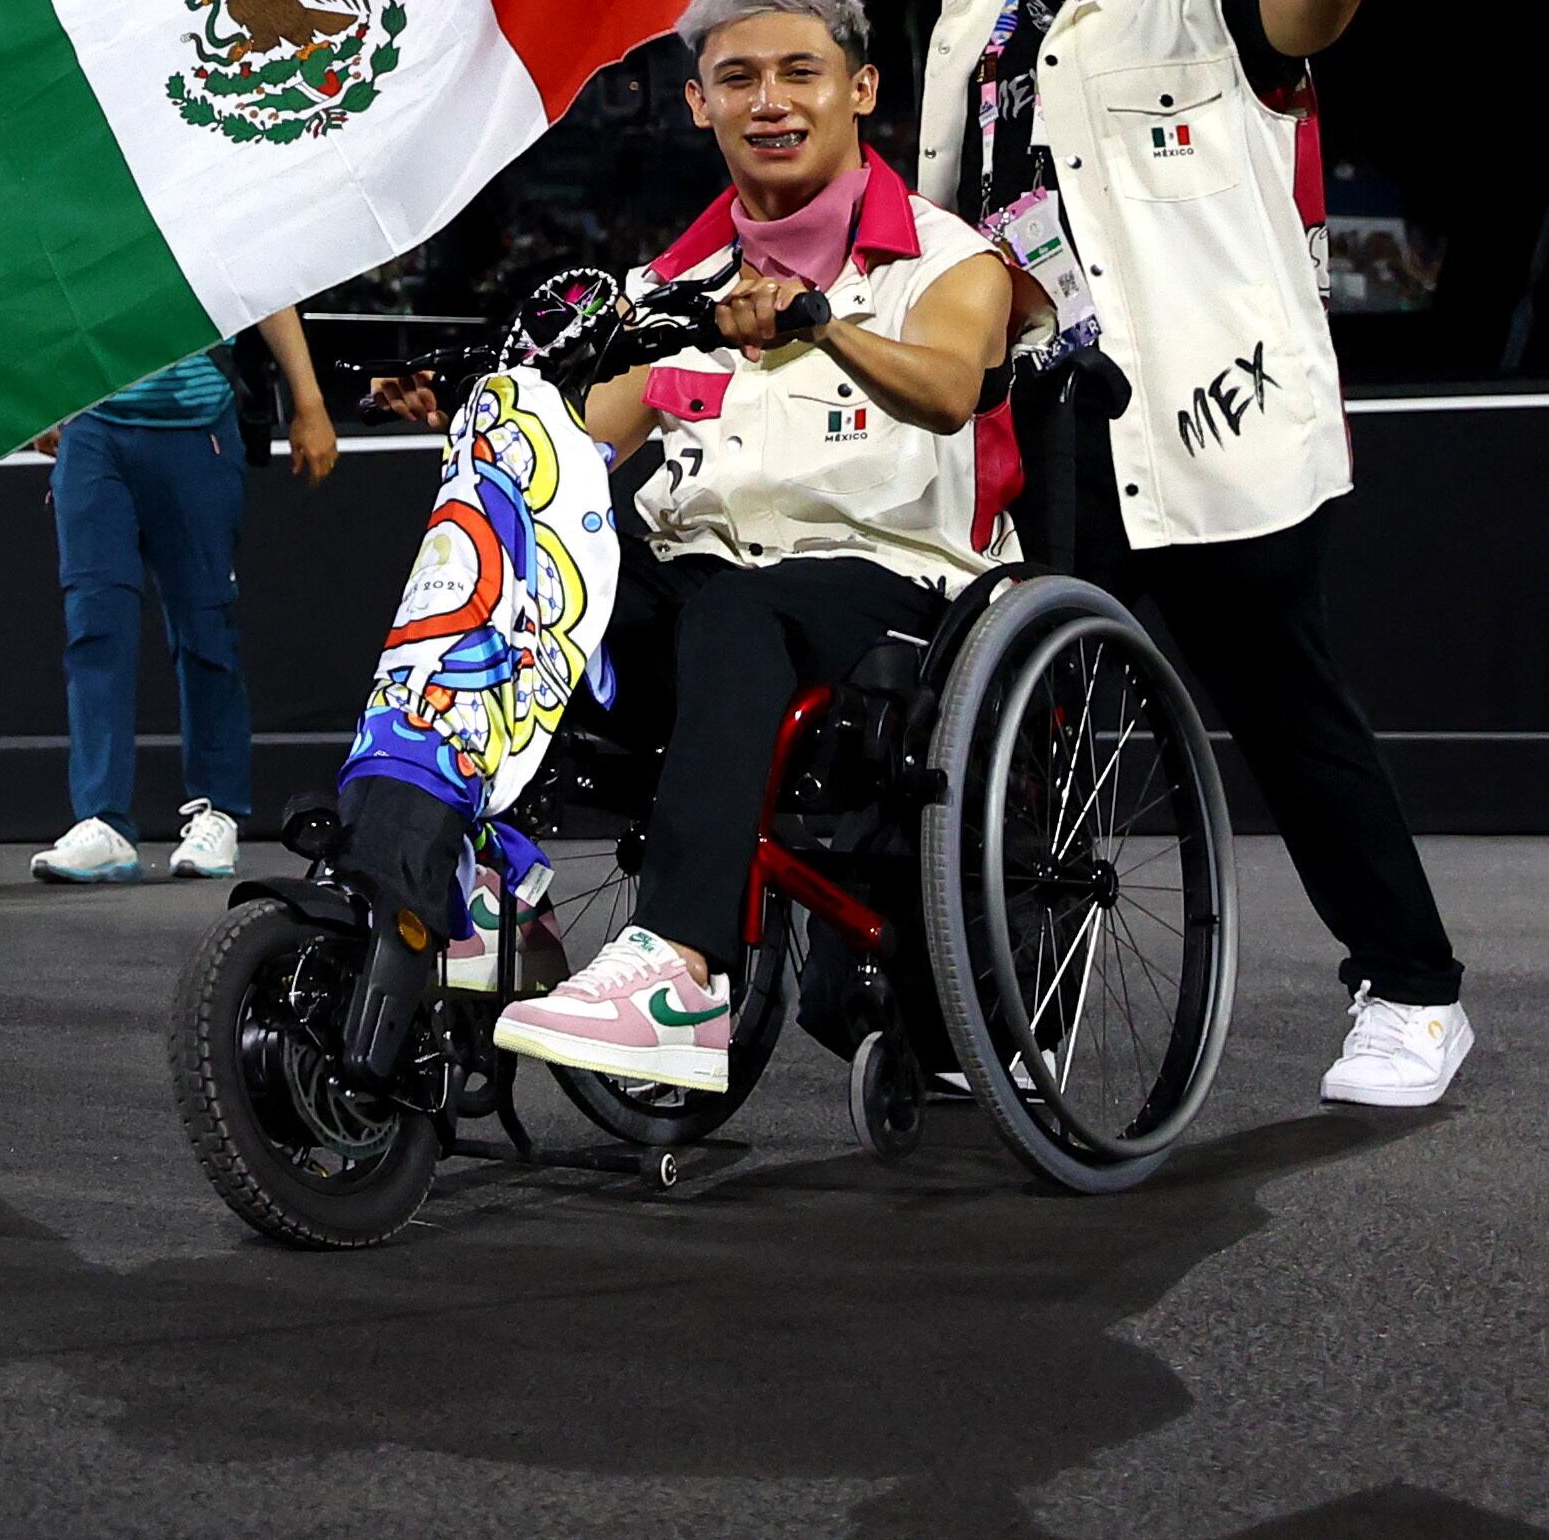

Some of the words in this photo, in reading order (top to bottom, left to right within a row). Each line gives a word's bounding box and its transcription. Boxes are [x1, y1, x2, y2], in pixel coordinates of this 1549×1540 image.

[1153, 148, 1194, 158] MÉXICO
[1177, 340, 1283, 458] MEX
[824, 432, 868, 442] MÉXICO
[423, 581, 464, 592] 2024
